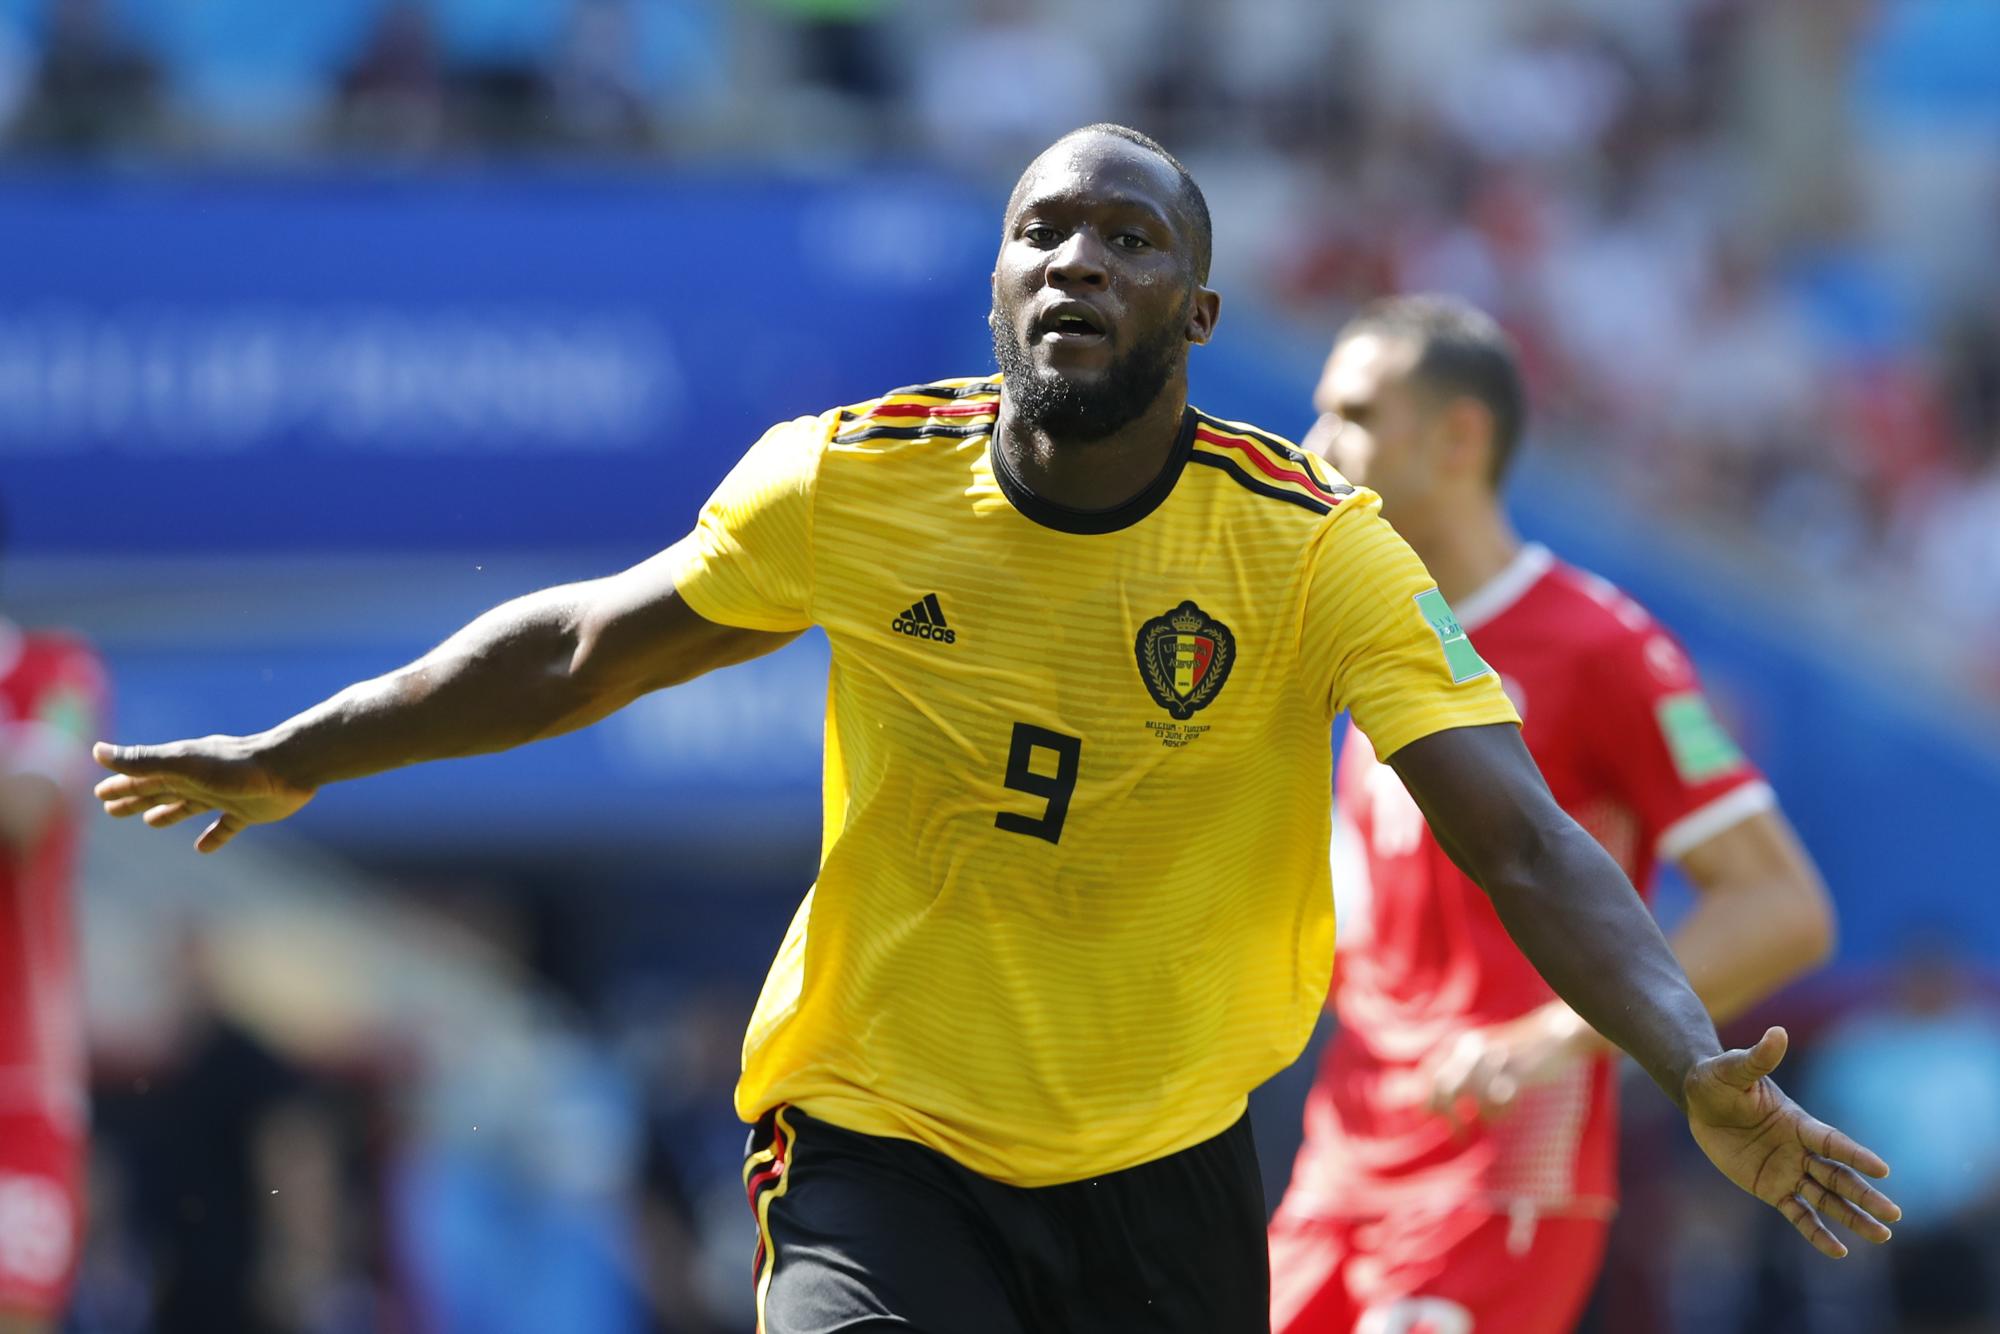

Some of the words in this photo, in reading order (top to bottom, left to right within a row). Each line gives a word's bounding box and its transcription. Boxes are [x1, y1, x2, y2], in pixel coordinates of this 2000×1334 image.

[892, 618, 956, 644] adidas
[1145, 721, 1176, 732] BELGIUM
[1184, 725, 1211, 734] TUNISIA
[1155, 730, 1164, 738] 23
[1165, 731, 1182, 740] JUNE
[994, 721, 1082, 845] 9
